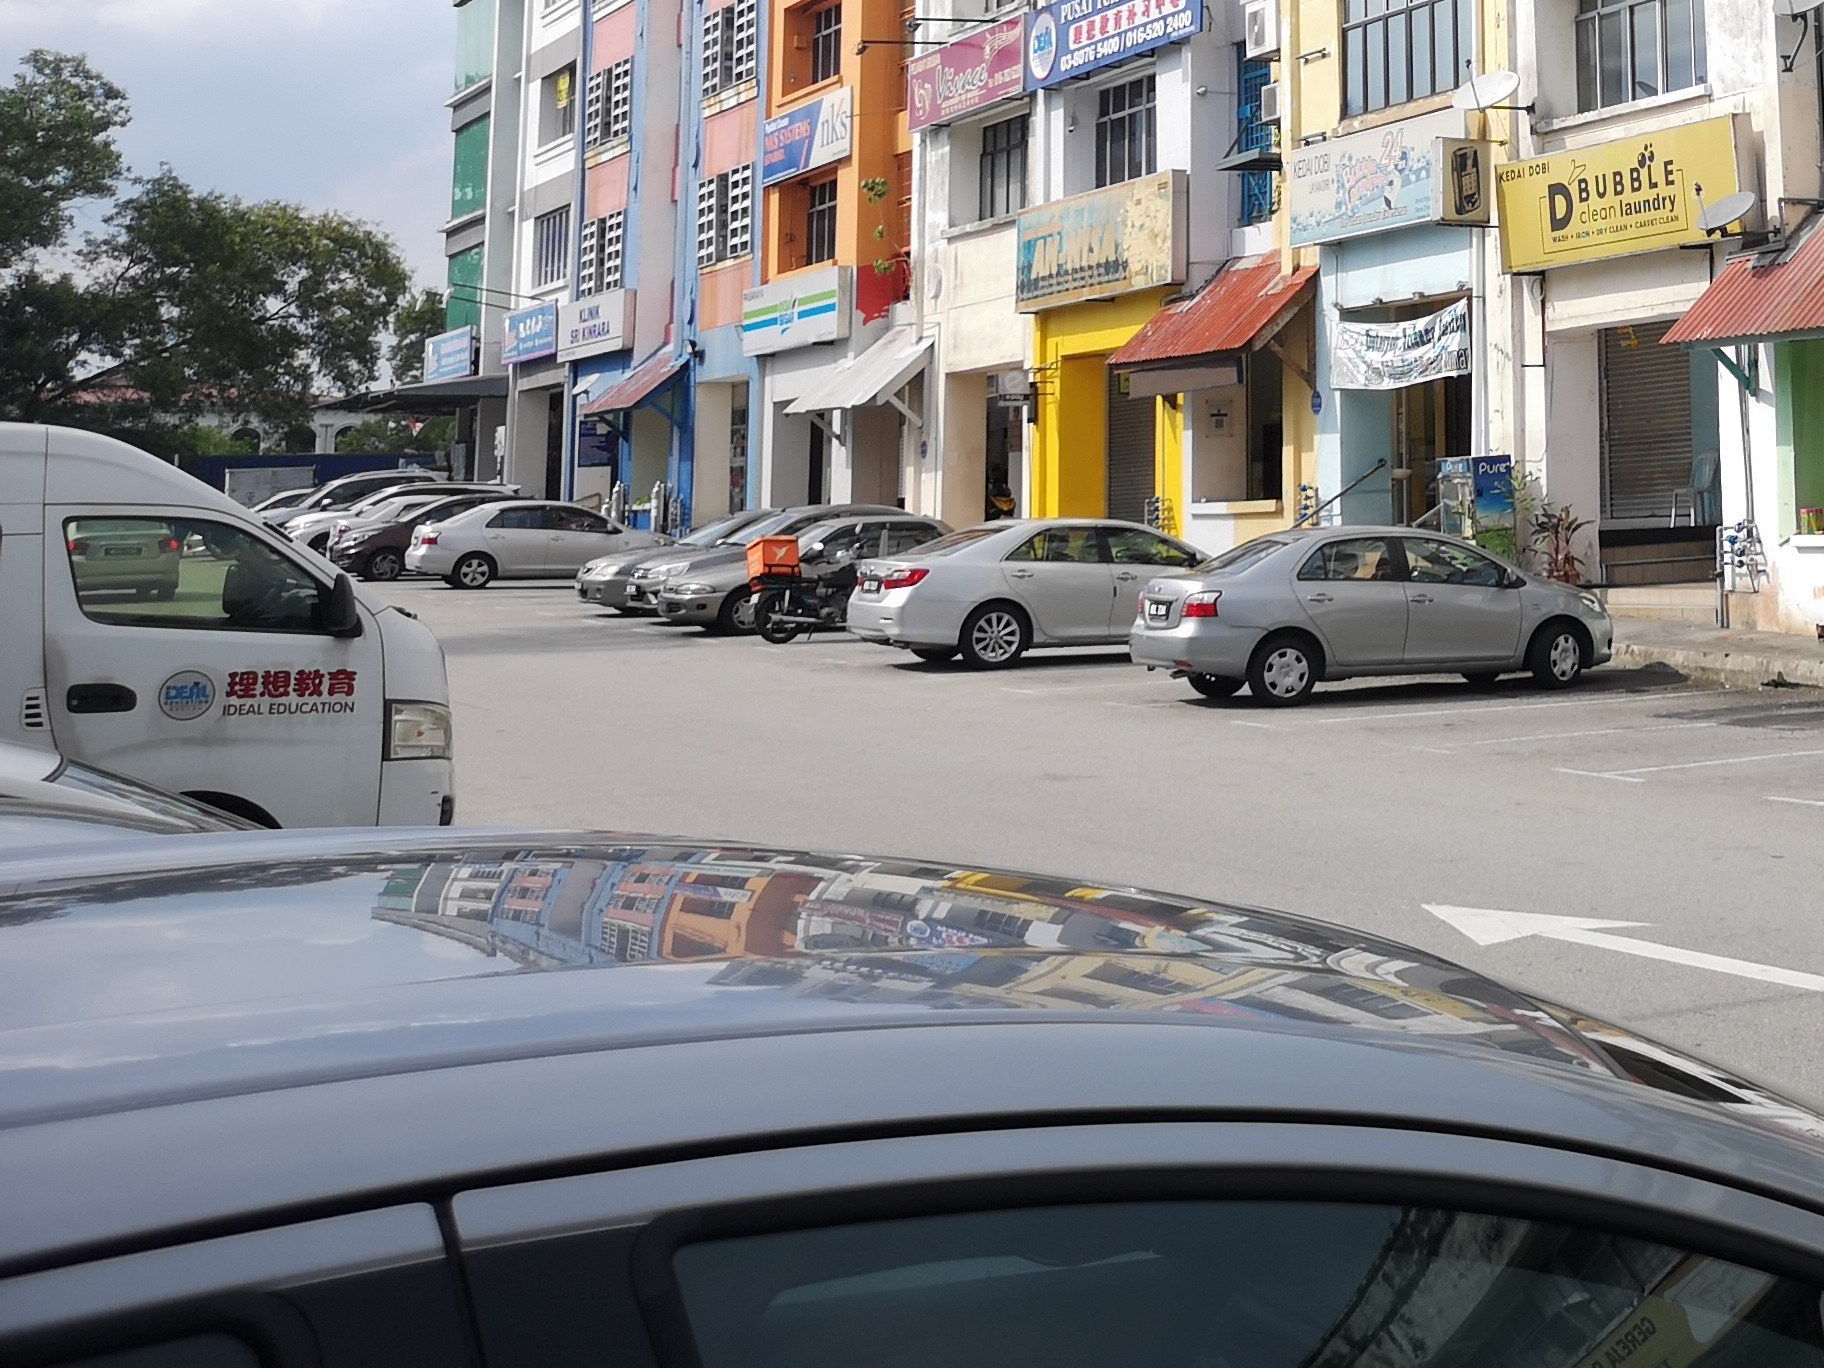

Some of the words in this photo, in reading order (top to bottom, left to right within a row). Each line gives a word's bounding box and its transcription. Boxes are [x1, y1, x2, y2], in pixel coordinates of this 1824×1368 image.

[1166, 10, 1192, 34] 2400
[1499, 166, 1525, 183] KEDAI
[1529, 162, 1550, 177] DOBI
[1578, 159, 1676, 204] BUBBLE
[1580, 202, 1617, 224] clean
[1619, 192, 1677, 218] laundry
[1596, 227, 1608, 236] DRY
[1609, 224, 1628, 234] CLEAN
[225, 668, 357, 699] 理想教育
[222, 702, 264, 717] IDEAL
[268, 701, 355, 715] EDUCATION
